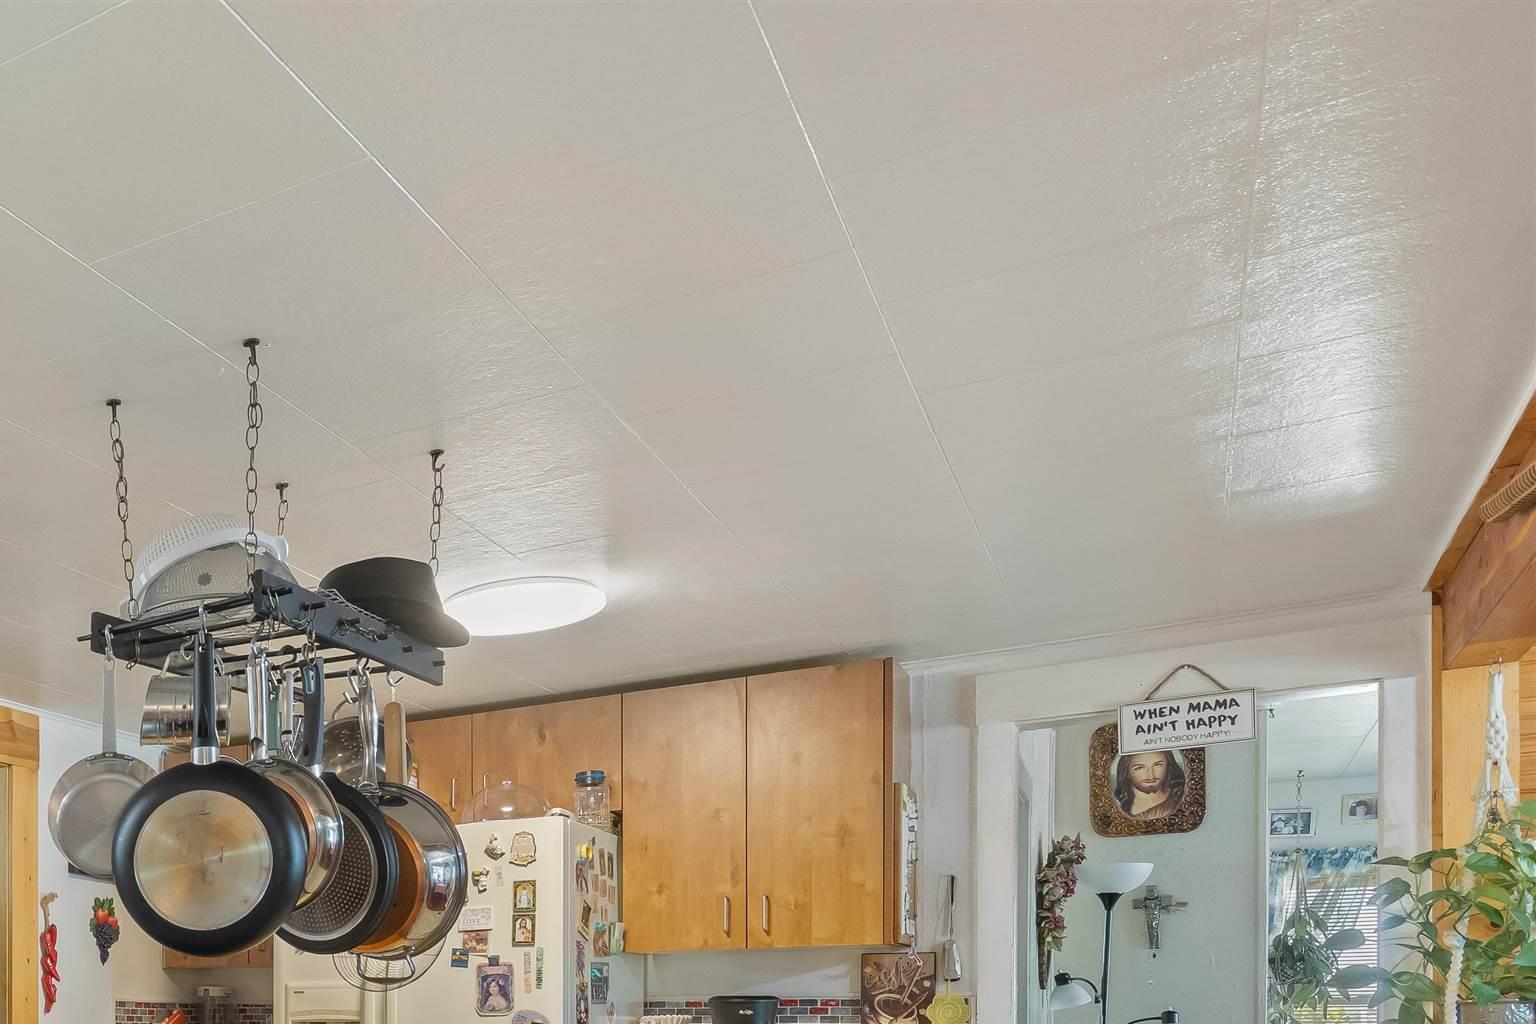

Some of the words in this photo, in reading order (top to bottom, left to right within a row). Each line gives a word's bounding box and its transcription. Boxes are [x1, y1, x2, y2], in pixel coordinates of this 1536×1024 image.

[1133, 705, 1180, 720] WHEN
[1187, 698, 1240, 715] MAMA
[1135, 720, 1178, 735] AIN'T
[1185, 714, 1238, 730] HAPPY
[1164, 734, 1198, 743] NOBODY
